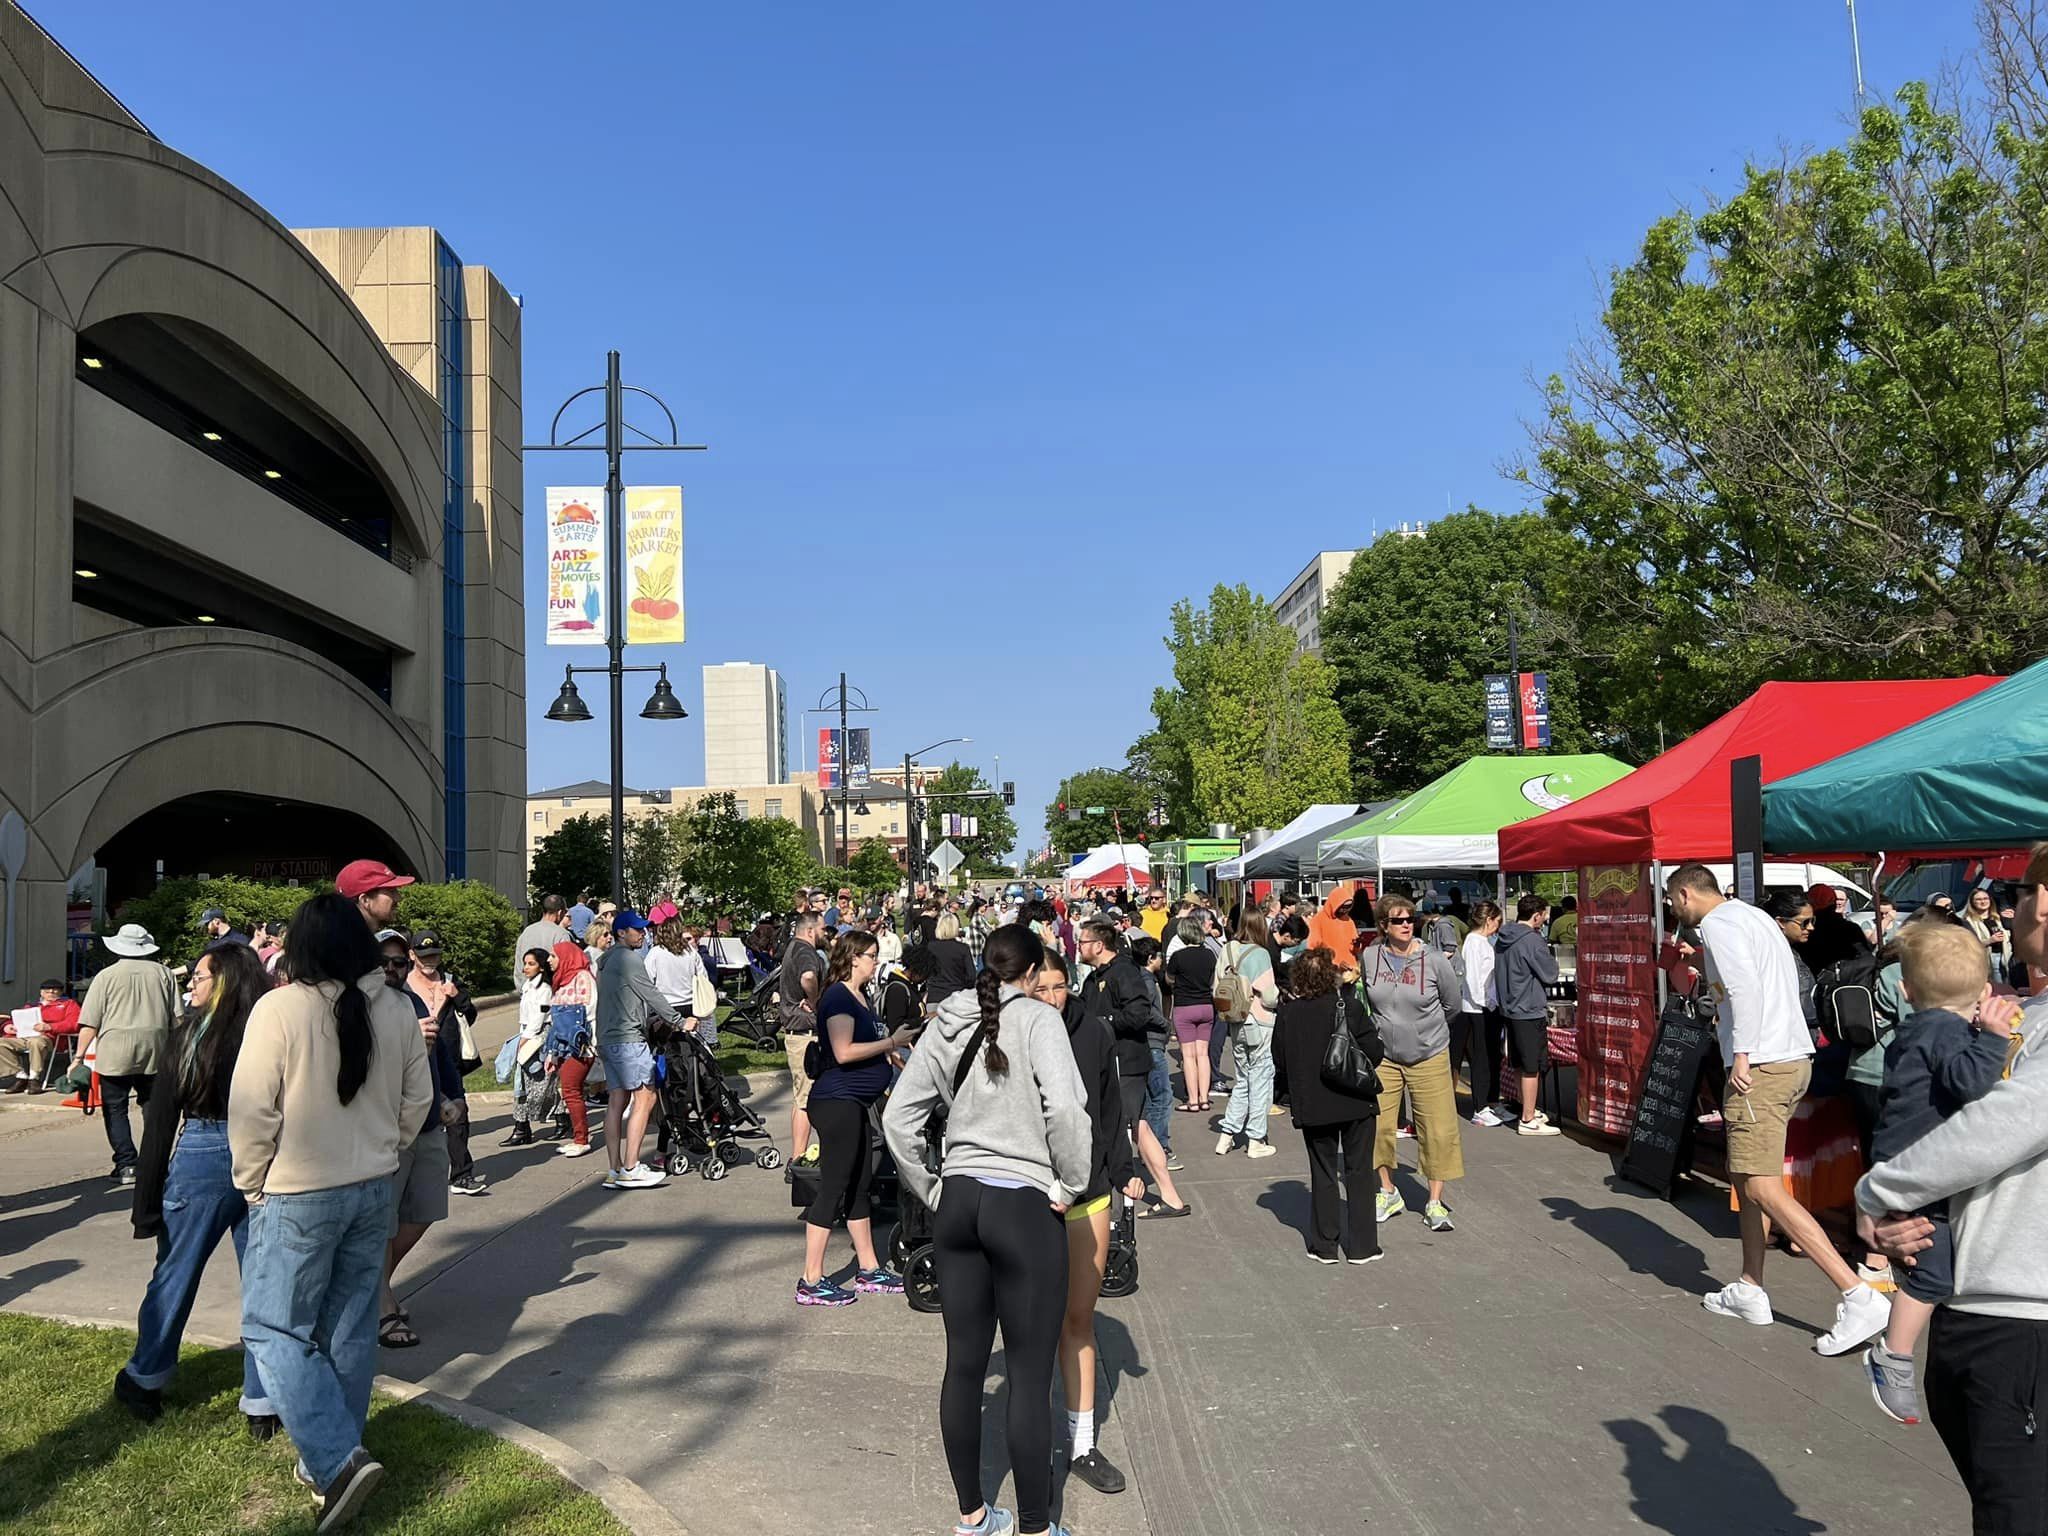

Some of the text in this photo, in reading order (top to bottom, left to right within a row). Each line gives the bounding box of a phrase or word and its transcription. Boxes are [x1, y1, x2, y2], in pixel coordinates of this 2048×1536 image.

[632, 510, 675, 520] IOWA CITY
[553, 524, 598, 536] SUMMER
[628, 527, 681, 543] FARMERS
[565, 532, 594, 543] ARTS
[628, 539, 681, 558] MARKET
[552, 549, 588, 561] ARTS
[560, 561, 592, 573] JAZZ
[550, 562, 560, 600] MUSIC
[560, 573, 601, 582] MOVIES
[549, 599, 576, 609] FUN
[254, 861, 328, 877] PAY STATION
